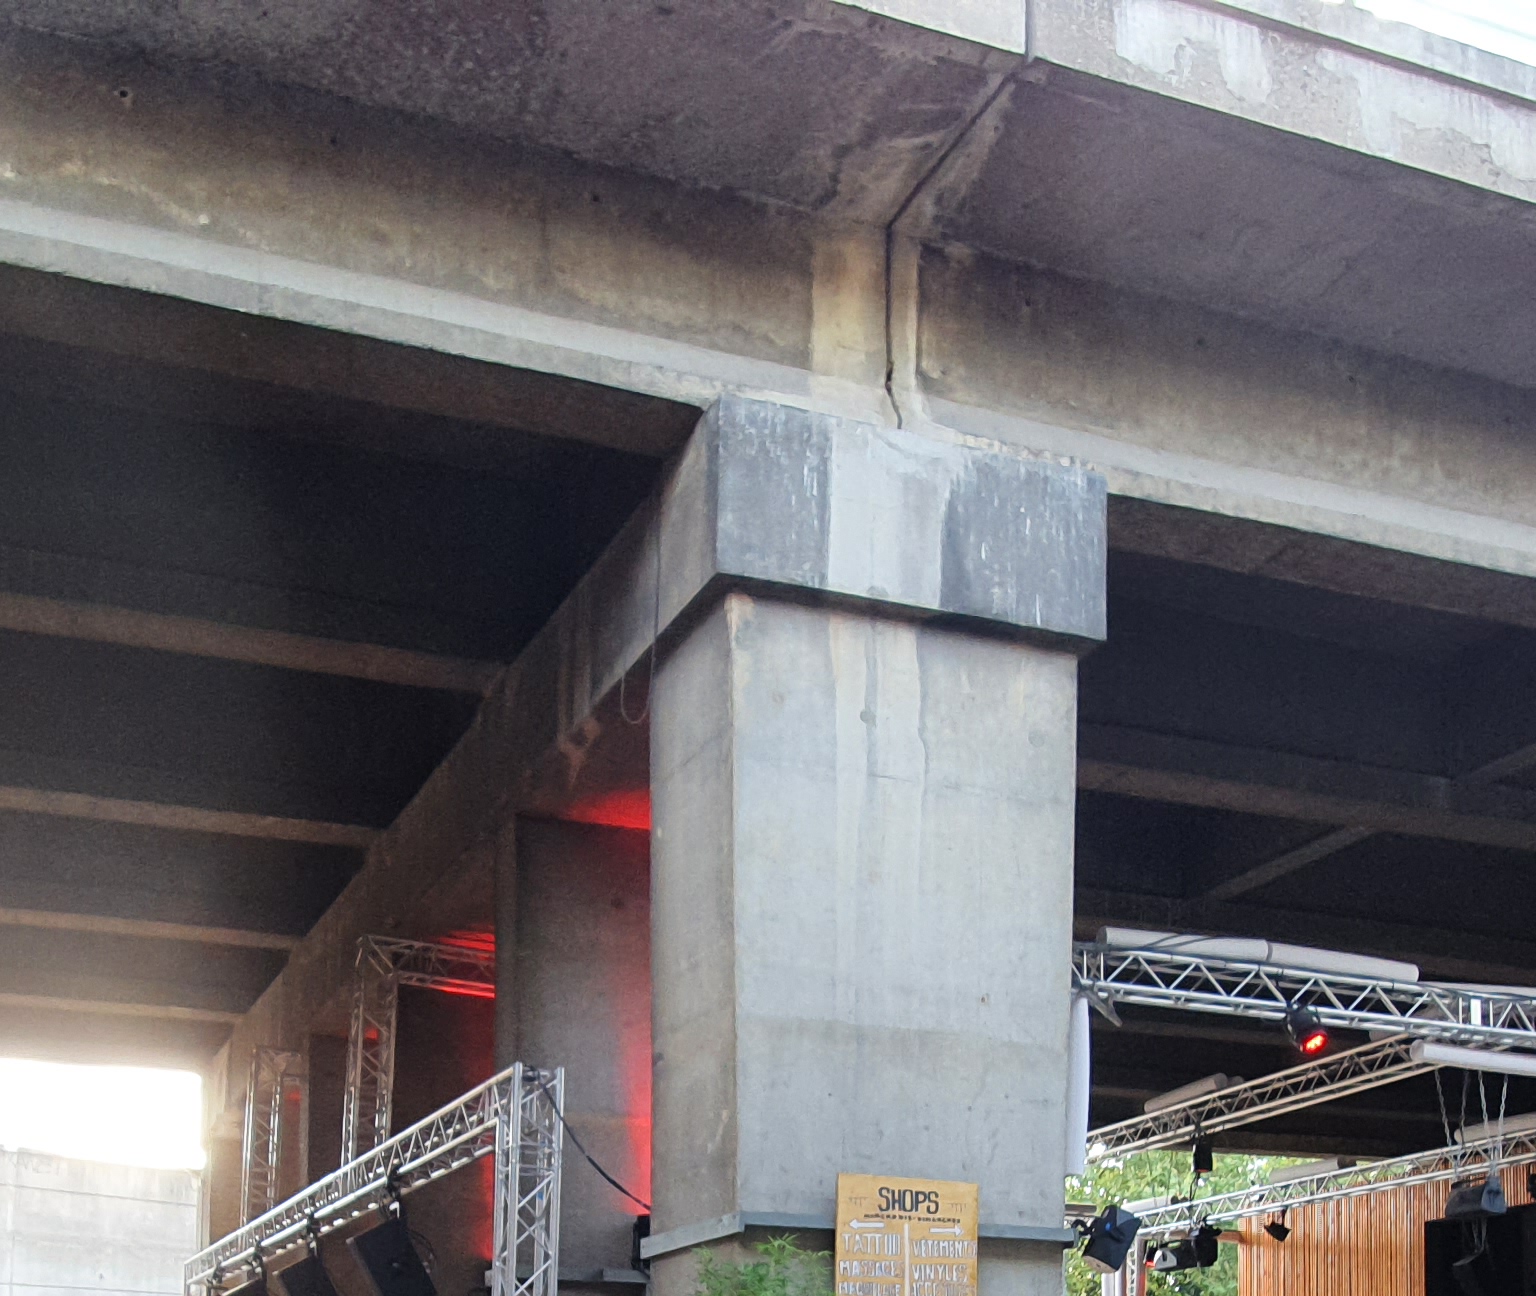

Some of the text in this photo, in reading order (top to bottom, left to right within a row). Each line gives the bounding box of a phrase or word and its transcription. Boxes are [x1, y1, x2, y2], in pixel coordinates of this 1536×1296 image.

[877, 1186, 939, 1214] SHOPS
[839, 1260, 903, 1278] MASSAGES
[911, 1263, 968, 1283] VINYLES
